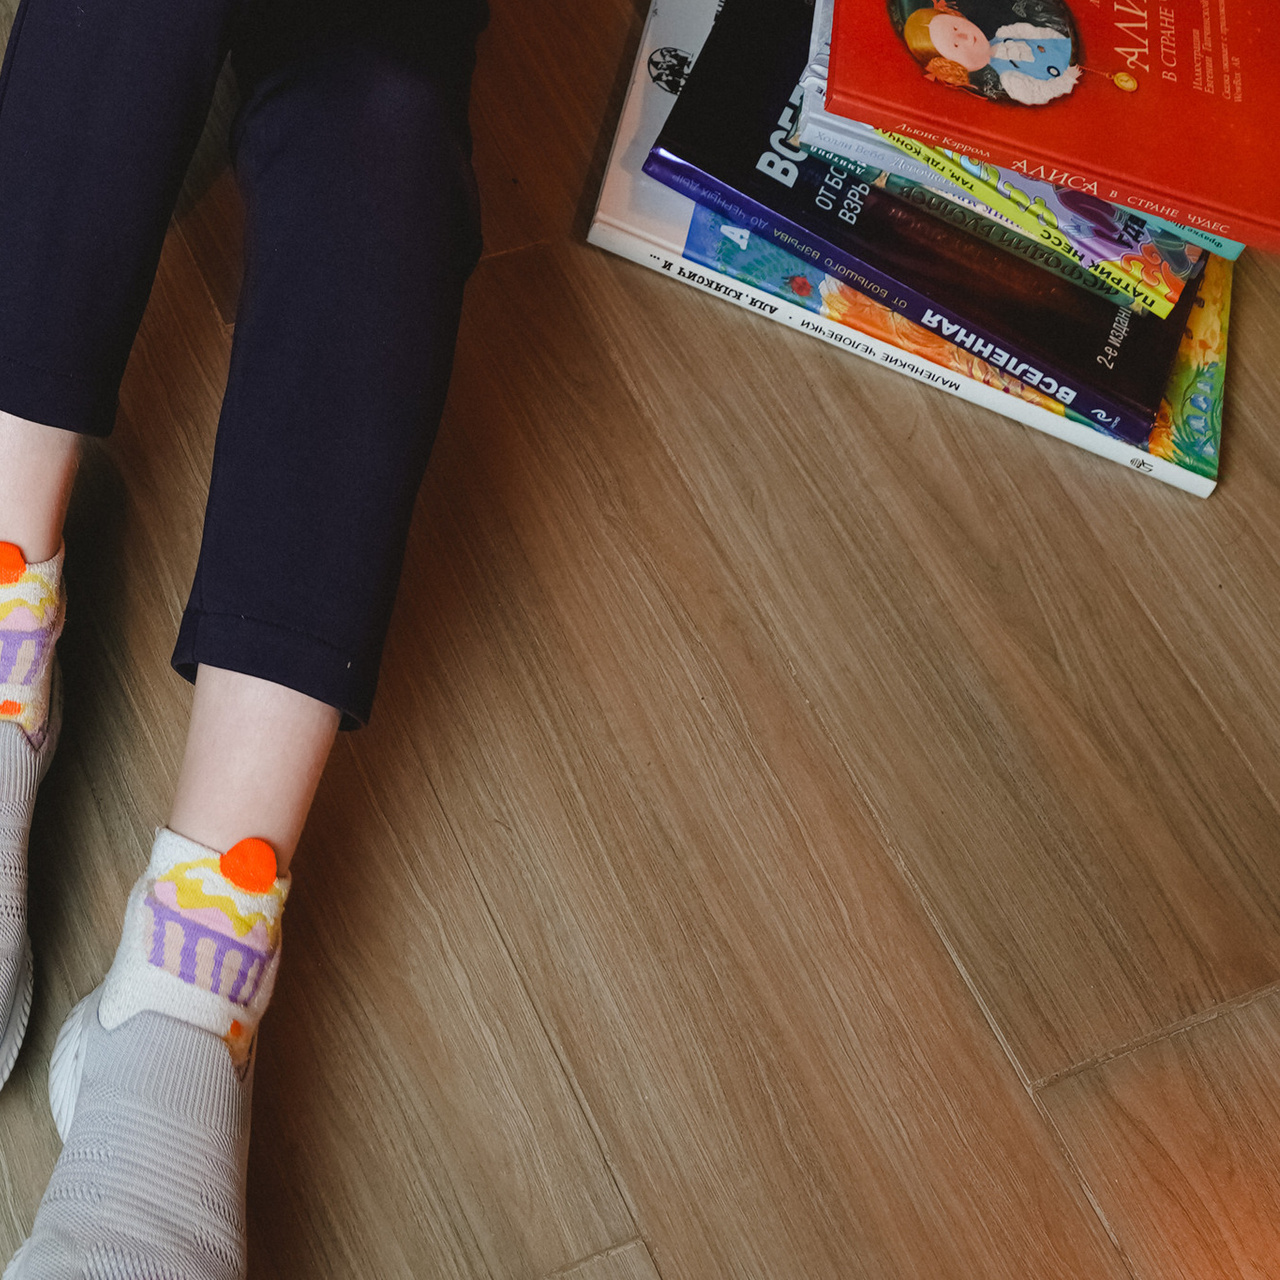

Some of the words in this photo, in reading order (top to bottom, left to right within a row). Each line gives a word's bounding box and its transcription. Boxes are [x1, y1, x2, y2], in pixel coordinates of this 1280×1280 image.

[1159, 6, 1176, 66] СТРАНЕ
[1161, 70, 1177, 82] В
[755, 84, 809, 189] ВСЕ
[920, 151, 948, 174] ГДЕ
[944, 166, 978, 193] ТАМ,
[815, 185, 837, 212] ОТ
[1010, 154, 1101, 198] АЛИСА
[1125, 193, 1180, 220] СТРАНЕ
[1184, 211, 1231, 235] ЧУДЕС
[773, 227, 820, 259] ВЗРЫВА
[1038, 226, 1087, 263] НЕСС
[676, 266, 743, 300] КЛЯКСИЧ
[824, 257, 888, 297] БОЛЬШОГО
[1083, 256, 1157, 309] ПАТРИК
[800, 319, 875, 356] ЧЕЛОВЕЧКИ
[920, 308, 1076, 404] ВСЕЛЕННАЯ
[882, 352, 960, 391] МАЛЕНЬКИЕ
[1097, 344, 1119, 370] 2-е
